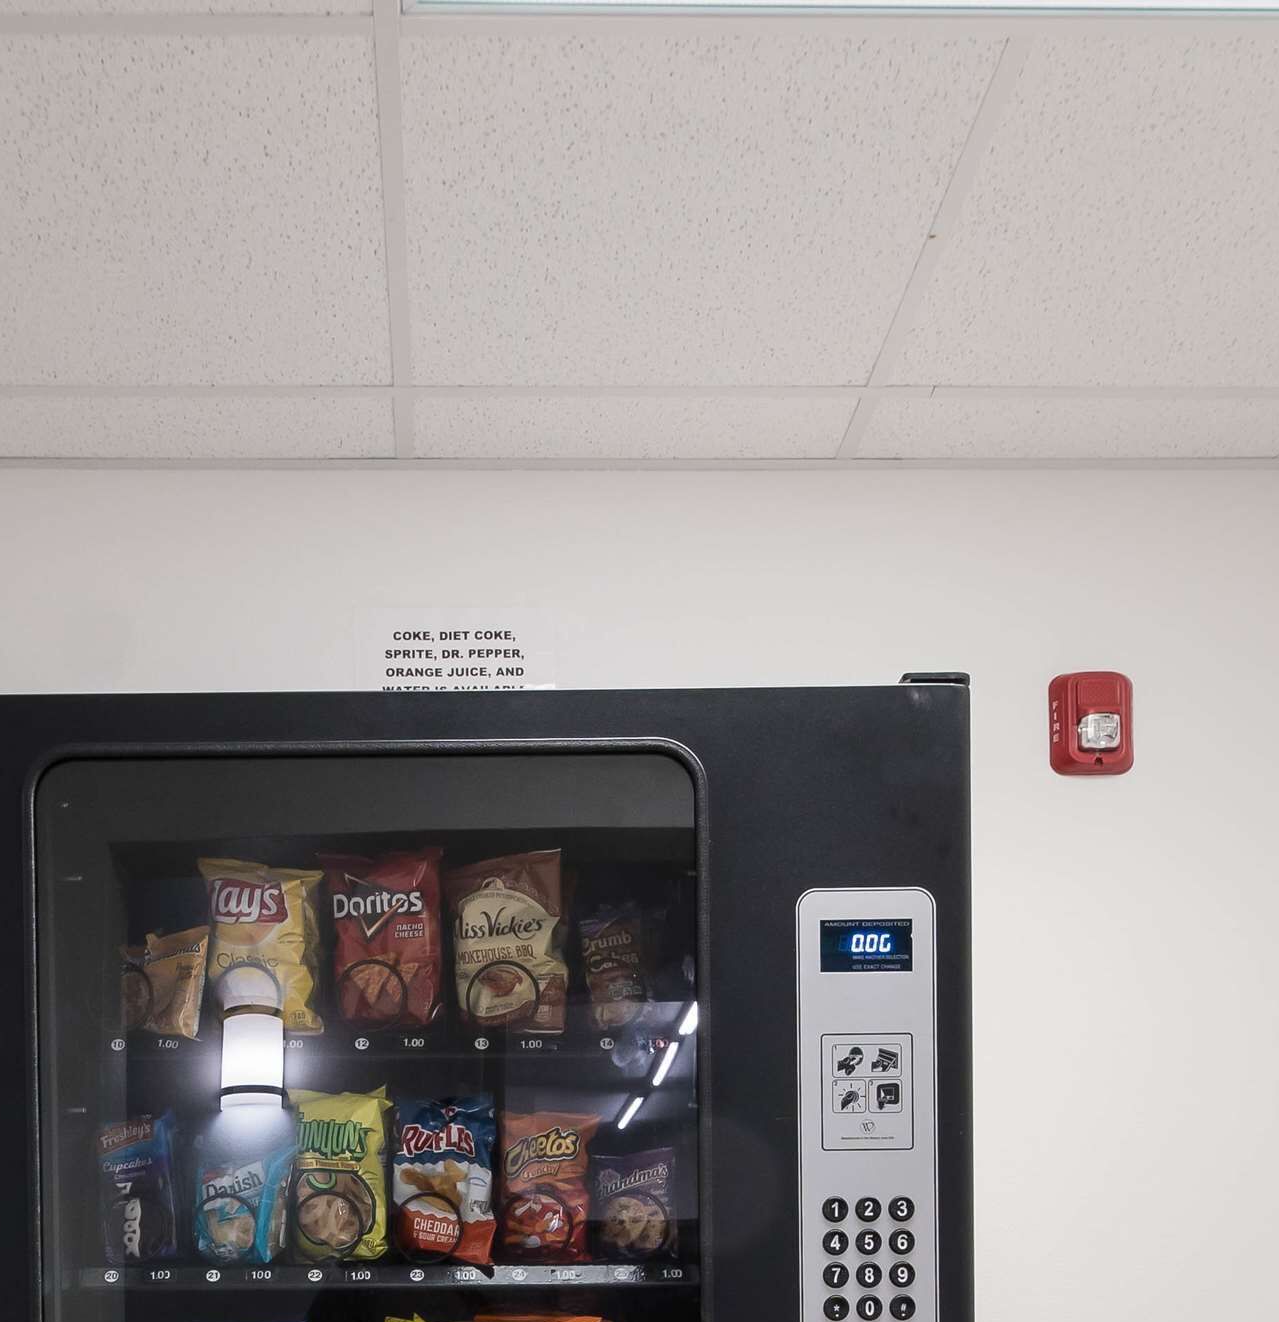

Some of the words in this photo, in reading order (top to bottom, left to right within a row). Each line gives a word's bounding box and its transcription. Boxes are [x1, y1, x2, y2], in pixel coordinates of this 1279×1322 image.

[392, 630, 435, 643] COKE,
[439, 630, 470, 641] DIET
[473, 630, 517, 642] COKE,
[384, 649, 437, 661] SPRITE,
[441, 649, 464, 659] DR.
[468, 648, 525, 660] PEPPER,
[385, 667, 443, 677] ORANGE
[447, 666, 492, 678] JUICE,
[495, 666, 525, 676] AND
[1051, 700, 1061, 743] FIRE
[332, 891, 423, 920] Doritos
[396, 922, 424, 932] NACHO
[480, 906, 544, 942] Vickie's
[394, 930, 424, 939] CHEESE
[456, 946, 514, 967] MOKEHOUSE
[515, 943, 537, 960] BBQ
[157, 1039, 179, 1049] 1.00
[402, 1038, 425, 1048] 1.00
[520, 1039, 543, 1049] 1.00
[506, 1127, 579, 1176] Cheetos
[205, 1170, 263, 1199] Danish
[831, 1201, 839, 1217] 1
[864, 1201, 874, 1216] 2
[896, 1200, 908, 1217] 3
[830, 1234, 841, 1250] 4
[864, 1234, 874, 1250] 5
[897, 1234, 908, 1250] 6
[831, 1267, 841, 1284] 7
[864, 1267, 875, 1283] 8
[897, 1267, 909, 1283] 9
[865, 1300, 875, 1316] 0
